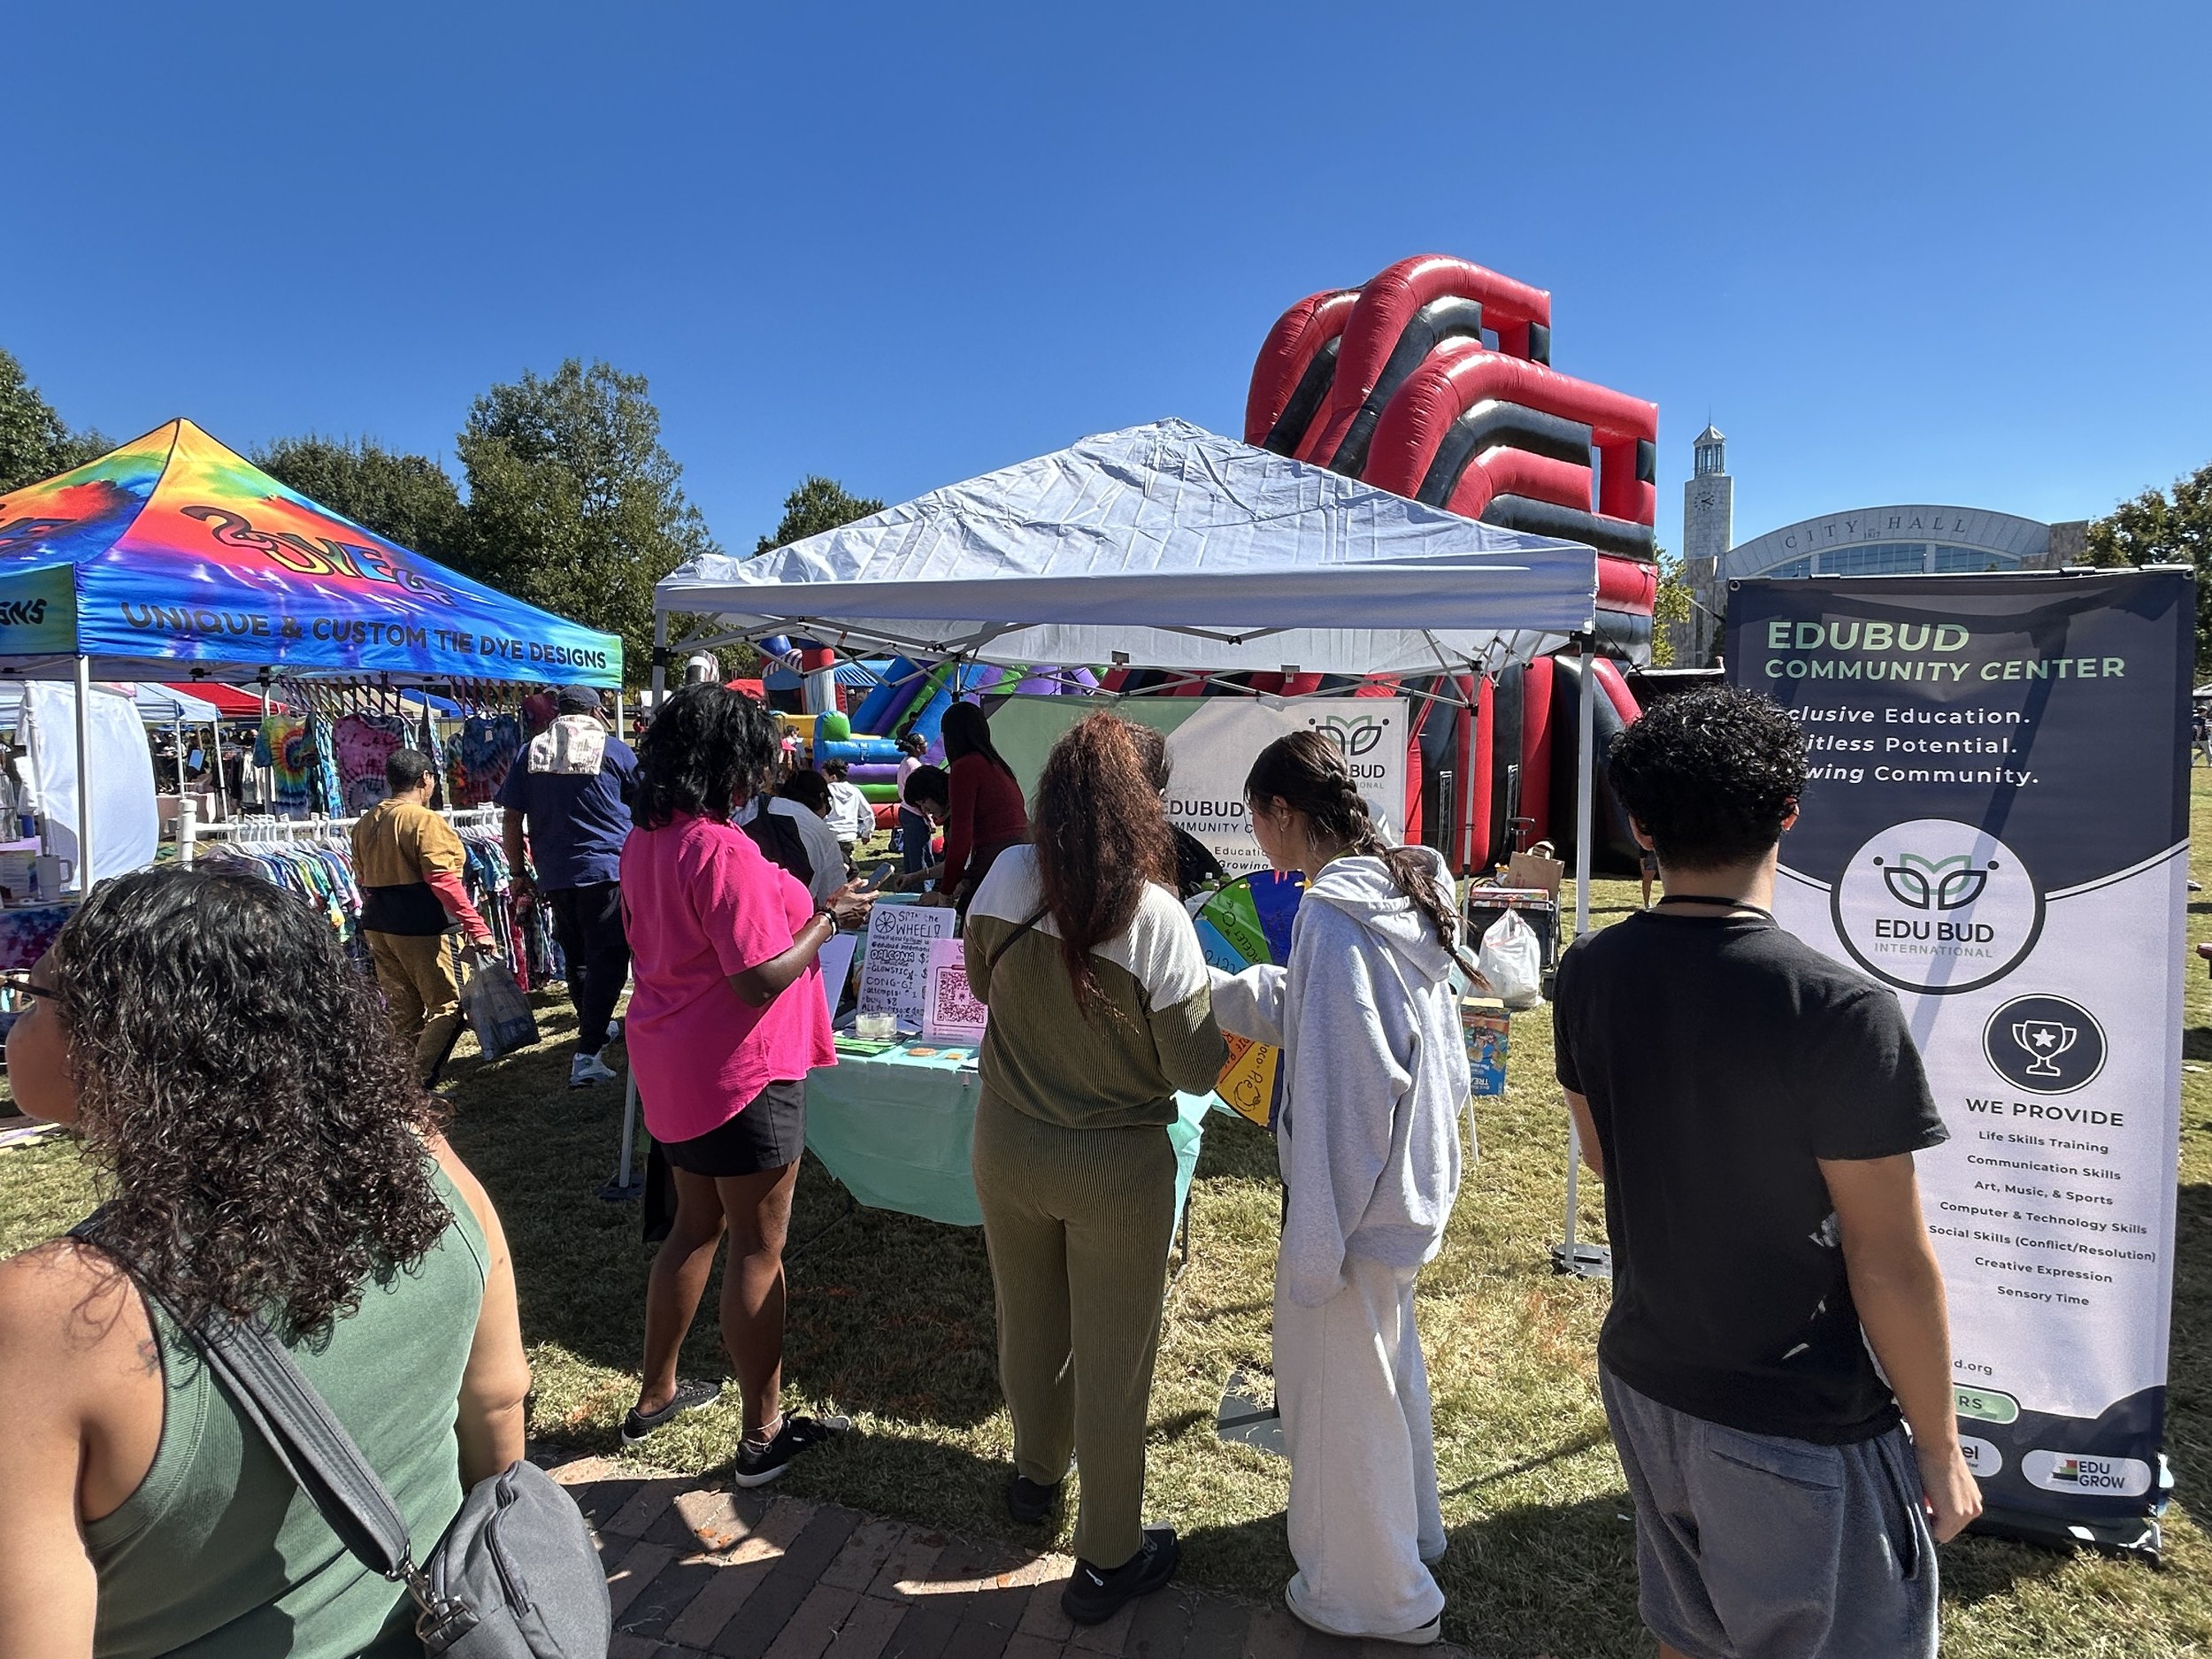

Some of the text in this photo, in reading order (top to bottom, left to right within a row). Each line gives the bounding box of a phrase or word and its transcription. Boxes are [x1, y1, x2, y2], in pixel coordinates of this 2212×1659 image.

[1785, 516, 1968, 549] CITY HALL
[120, 602, 607, 669] UNIQUE & CUSTOM TIE DYE DESIGNS
[1768, 622, 1970, 651] EDUBUD
[1764, 657, 2125, 681] COMMUNITY CENTER
[1787, 706, 2031, 725] clusive Education.
[1807, 734, 2017, 753] itless Potential.
[1806, 764, 2039, 787] wing Community.
[1174, 821, 1240, 833] MMUNITY
[1214, 846, 1267, 856] Educatio
[1875, 919, 1994, 943] EDU BUD
[1232, 931, 1263, 964] ACELET
[1874, 942, 1993, 958] INTERNATIONAL
[1965, 1098, 2124, 1127] WE PROVIDE
[1978, 1131, 2109, 1155] Life Skills Training
[1967, 1155, 2122, 1180] Communication Skills
[1974, 1180, 2114, 1206] Art, Music, & Sports
[1939, 1202, 2147, 1235] Computer & Technology Skills
[1929, 1225, 2156, 1263] Social Skills (Conflict/Resolution)
[1975, 1256, 2113, 1283] Creative Expression
[1997, 1286, 2090, 1306] Sensory Time
[2079, 1461, 2110, 1475] EDU
[2079, 1474, 2125, 1489] GROW
